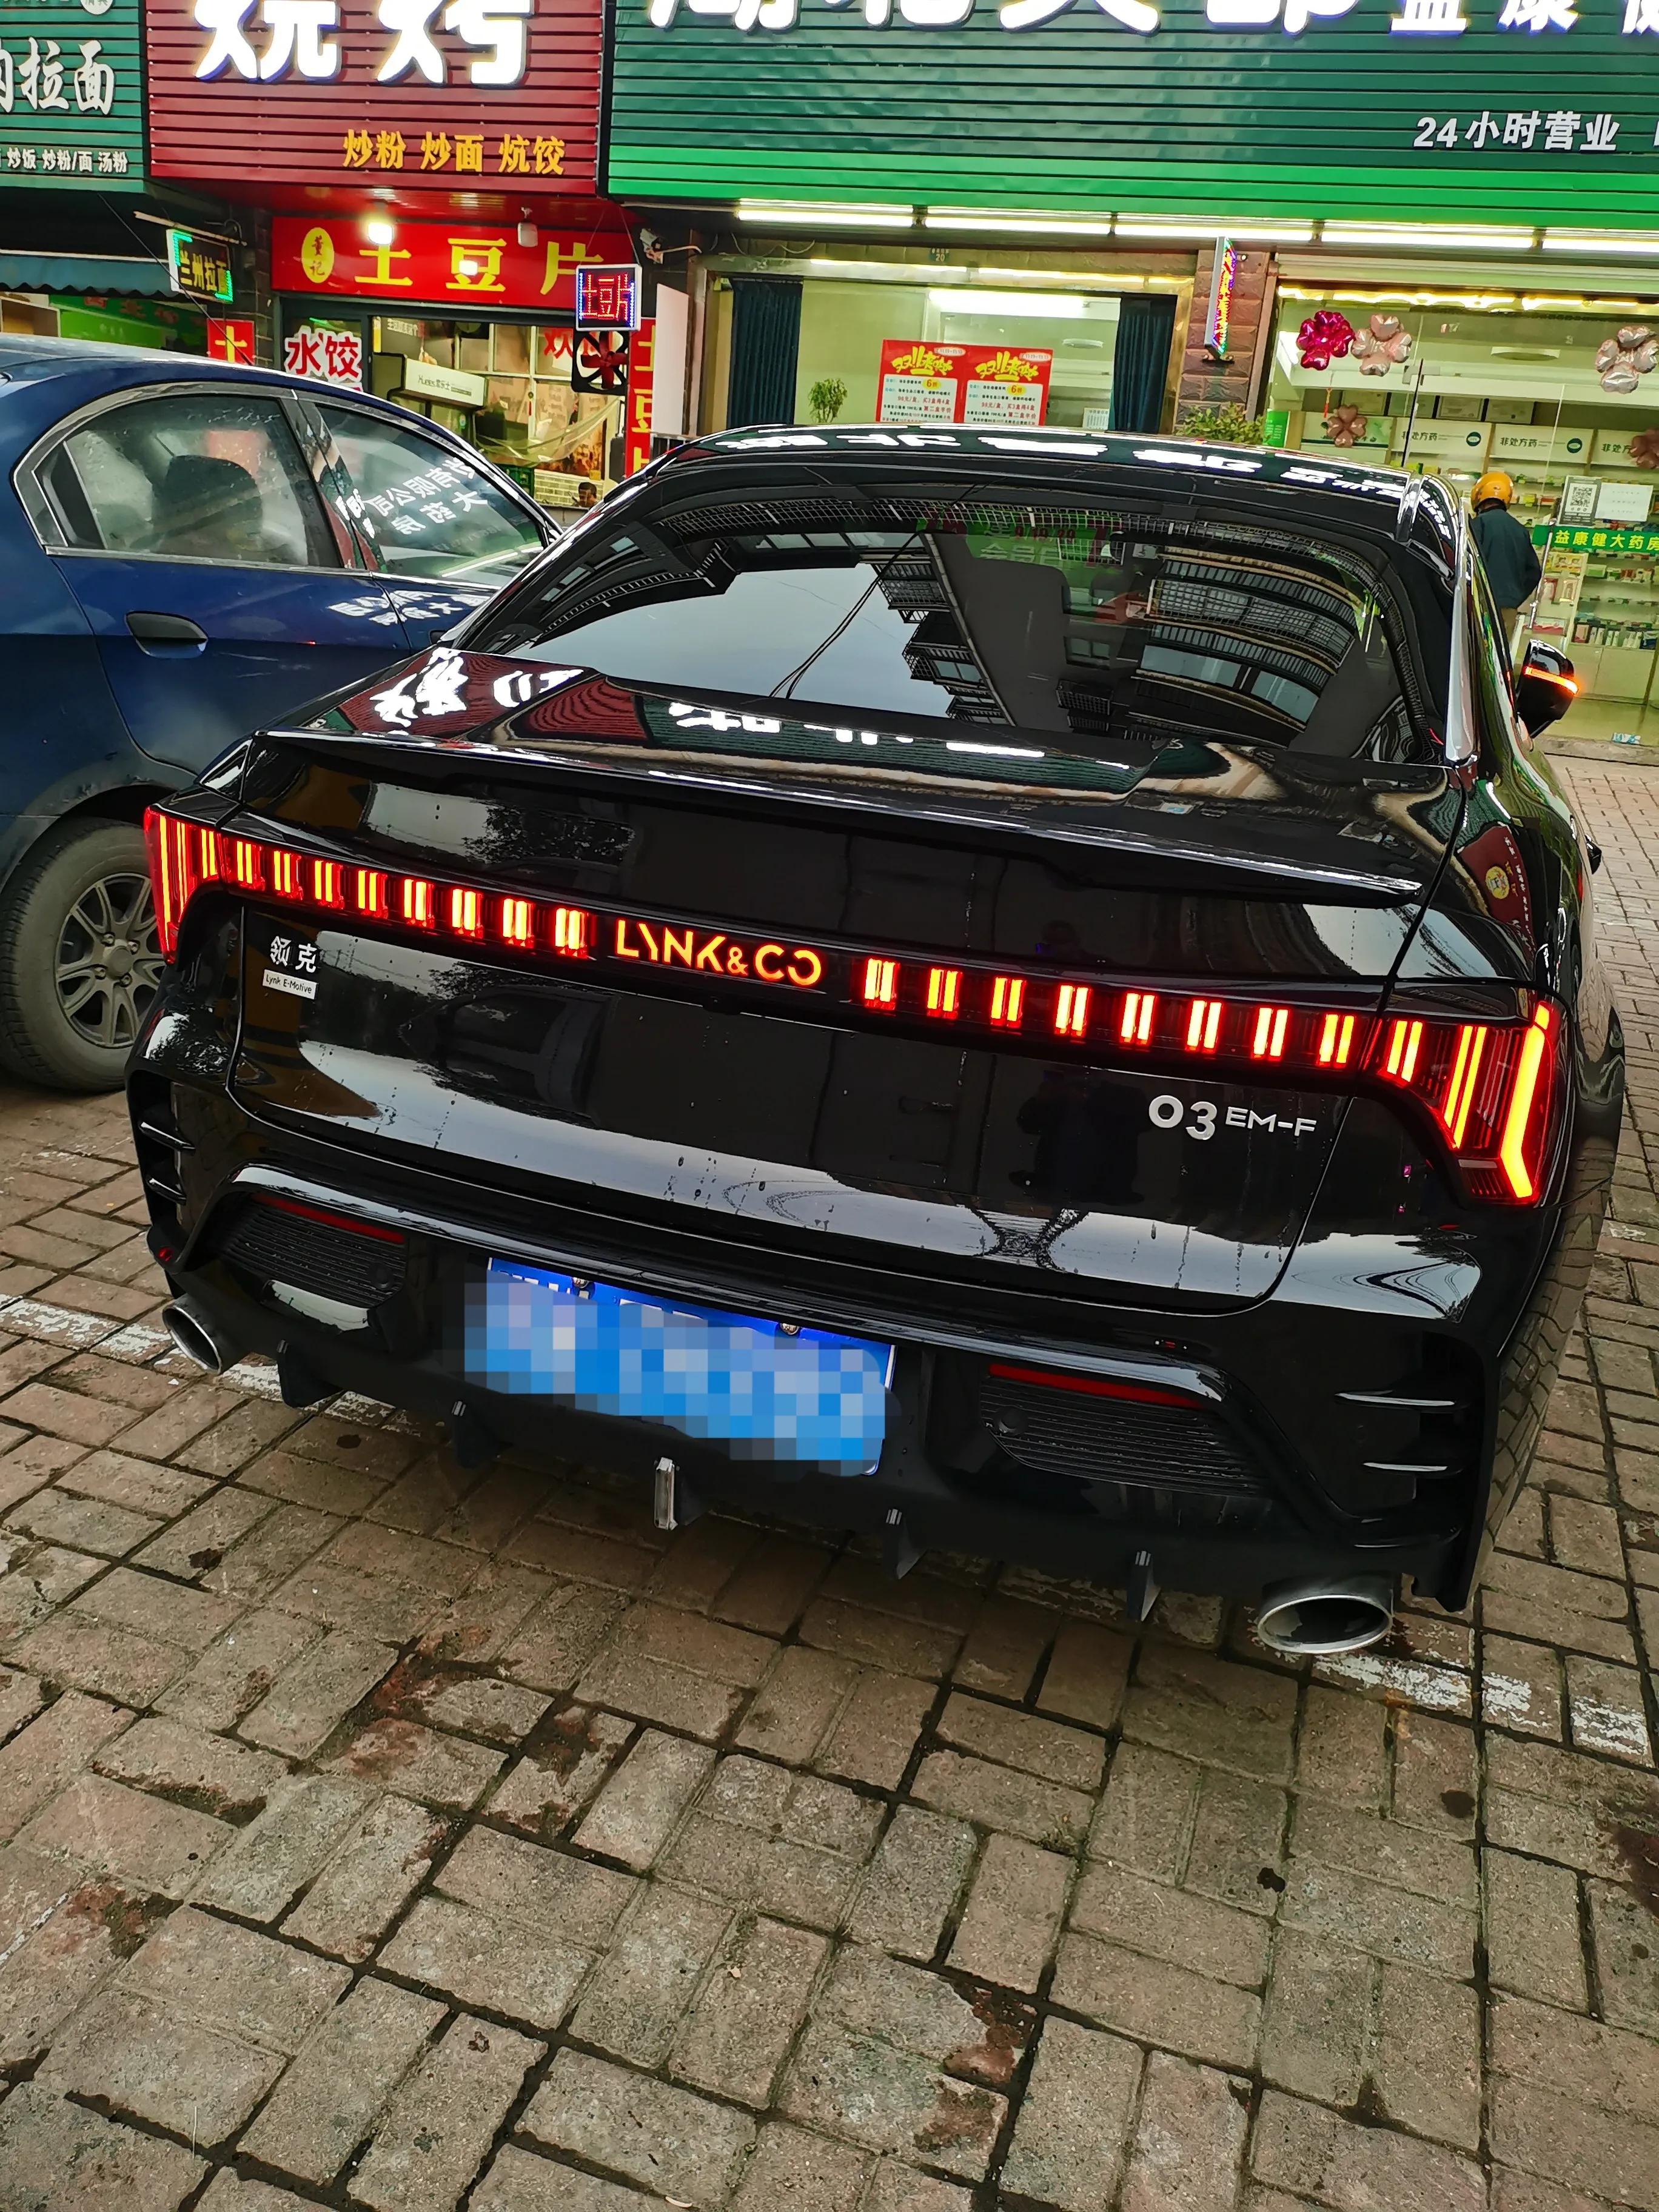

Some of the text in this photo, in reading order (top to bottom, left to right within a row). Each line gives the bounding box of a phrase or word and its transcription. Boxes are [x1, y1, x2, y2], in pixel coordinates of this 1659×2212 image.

[1413, 110, 1620, 151] 24小时营业
[7, 147, 36, 170] 炒饭
[42, 149, 93, 172] 炒粉/面
[98, 151, 128, 173] 汤粉
[343, 129, 565, 175] 炒粉 炒面 炕饺
[581, 273, 632, 322] 土豆片
[287, 333, 359, 378] 水饺
[1500, 437, 1538, 448] 非处方药
[1554, 529, 1659, 551] 益康健大药房
[270, 936, 317, 973] 领克
[266, 974, 312, 994] Lynk E-Motive
[1225, 1106, 1317, 1137] EM-F
